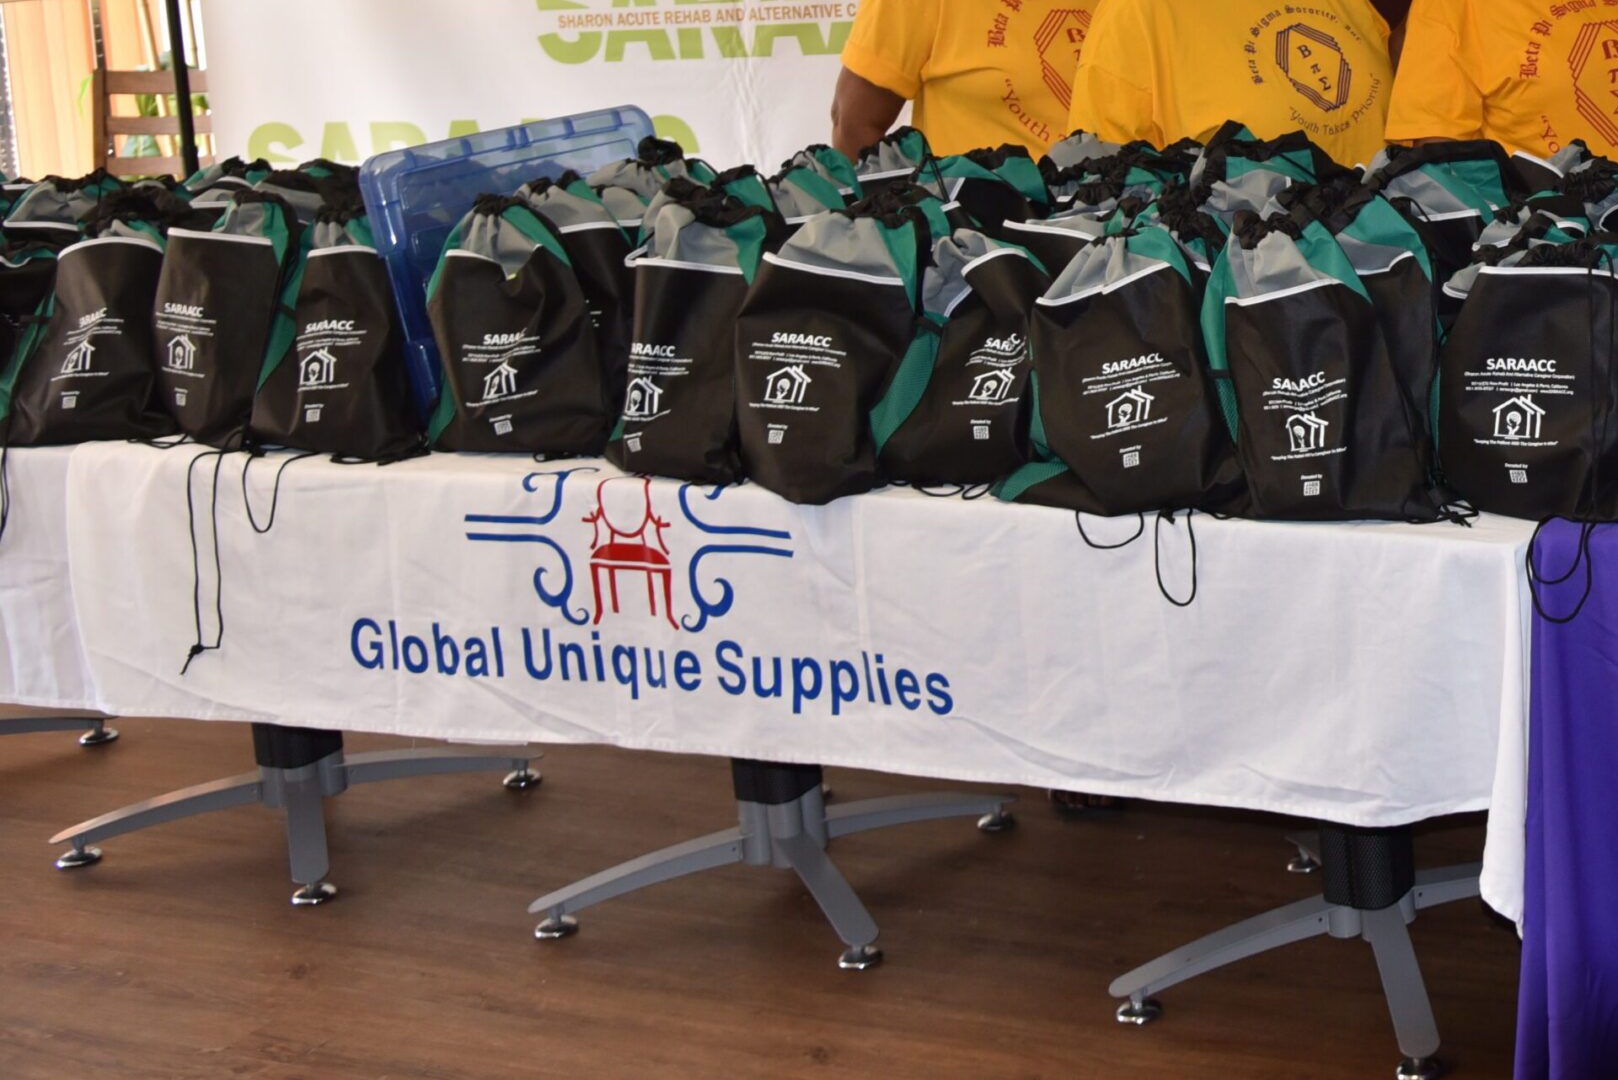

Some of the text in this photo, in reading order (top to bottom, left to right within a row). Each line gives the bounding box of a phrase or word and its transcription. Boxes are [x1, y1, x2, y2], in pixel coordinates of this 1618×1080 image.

[558, 13, 614, 29] SHARON
[617, 11, 661, 27] ACUTE
[664, 8, 712, 25] REHAB
[715, 7, 745, 22] AND
[749, 4, 844, 22] ALTERNATIVE
[987, 13, 1010, 48] Beta
[1520, 41, 1542, 79] Beta
[1531, 19, 1553, 36] Pi
[164, 302, 204, 318] SARAACC
[771, 331, 832, 348] SARAACC
[1486, 357, 1556, 372] SARAACC
[350, 616, 954, 717] Global Unique Supplies
